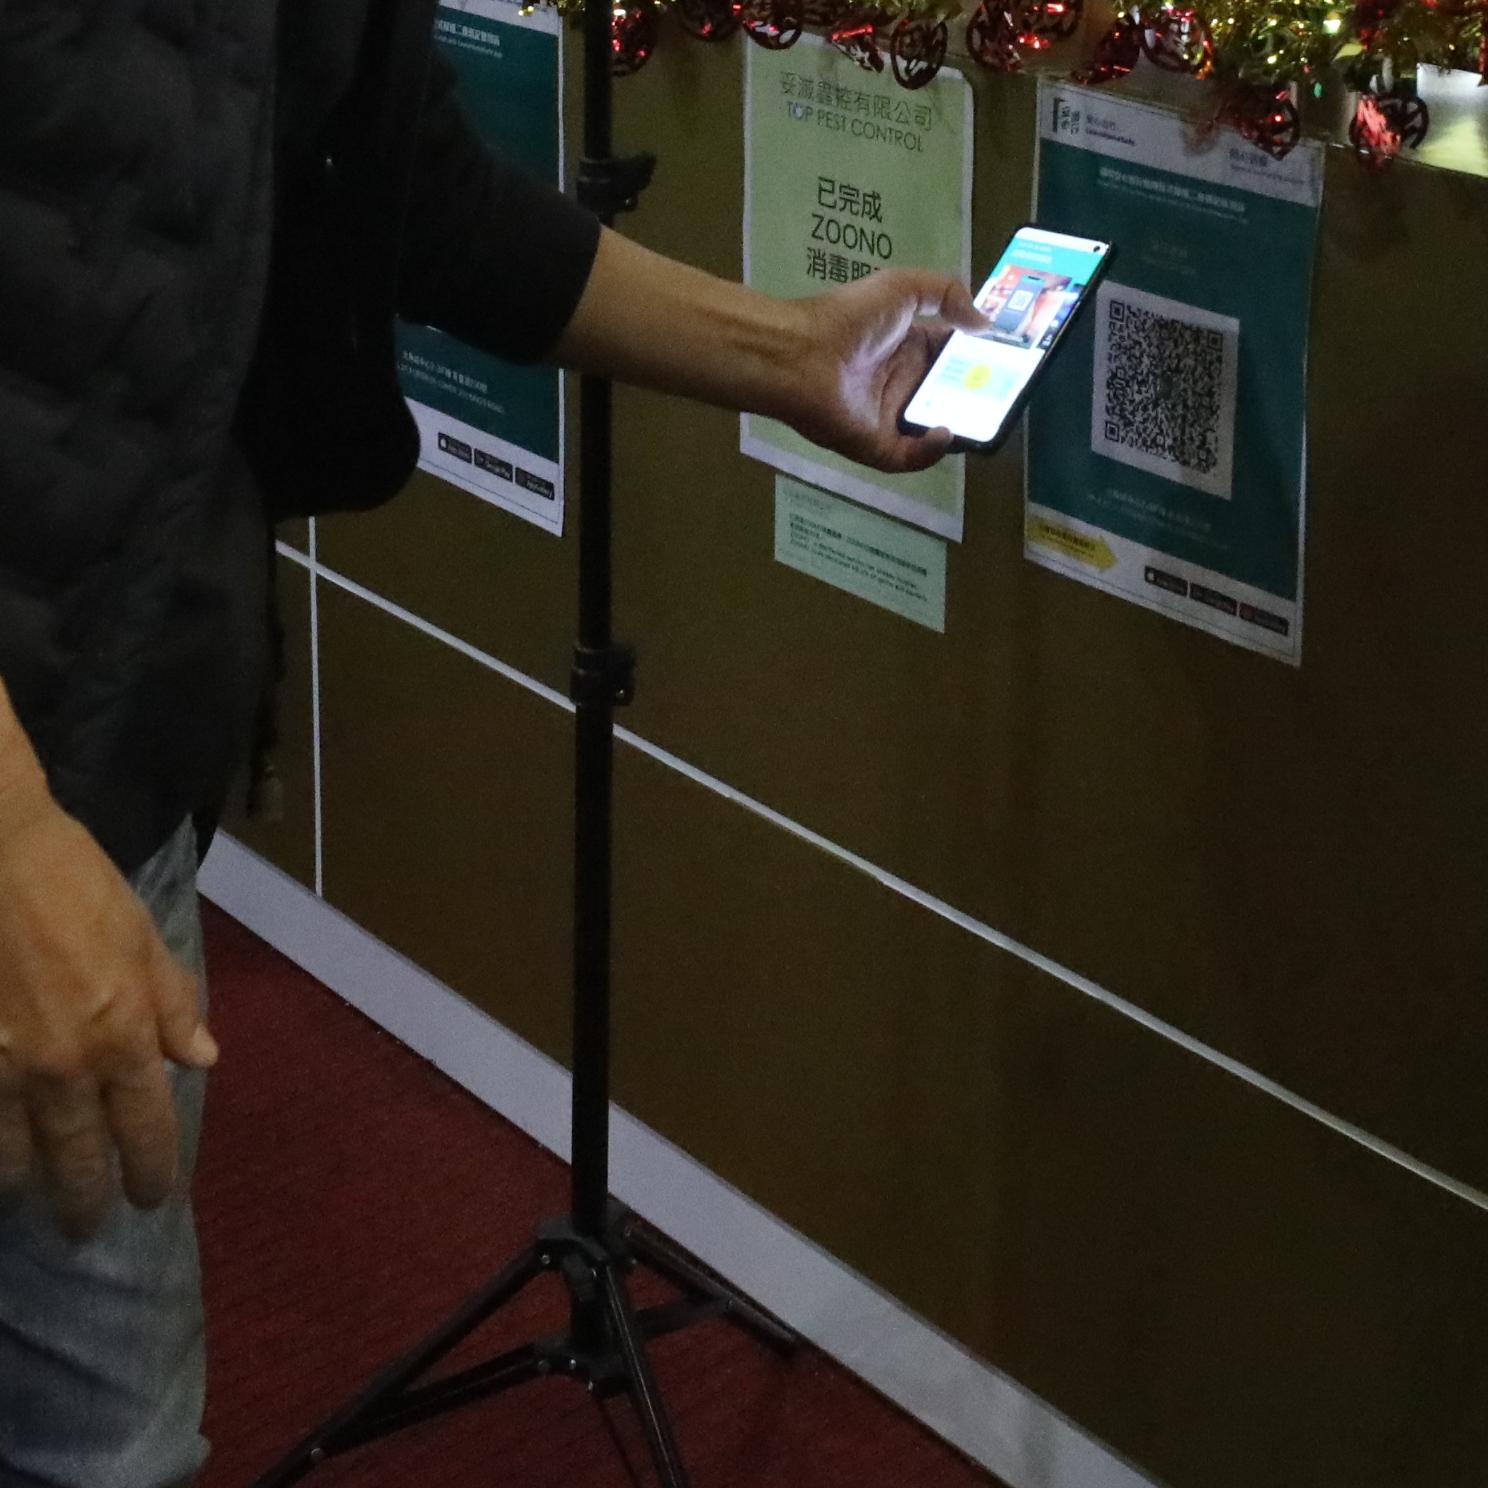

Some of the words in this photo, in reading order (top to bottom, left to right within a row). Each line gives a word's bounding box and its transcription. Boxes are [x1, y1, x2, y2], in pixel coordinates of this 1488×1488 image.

[817, 109, 847, 132] PEST
[850, 117, 924, 153] CONTROL
[817, 176, 883, 223] 已完成
[811, 213, 893, 260] ZOONO
[806, 246, 882, 284] 消毒服
